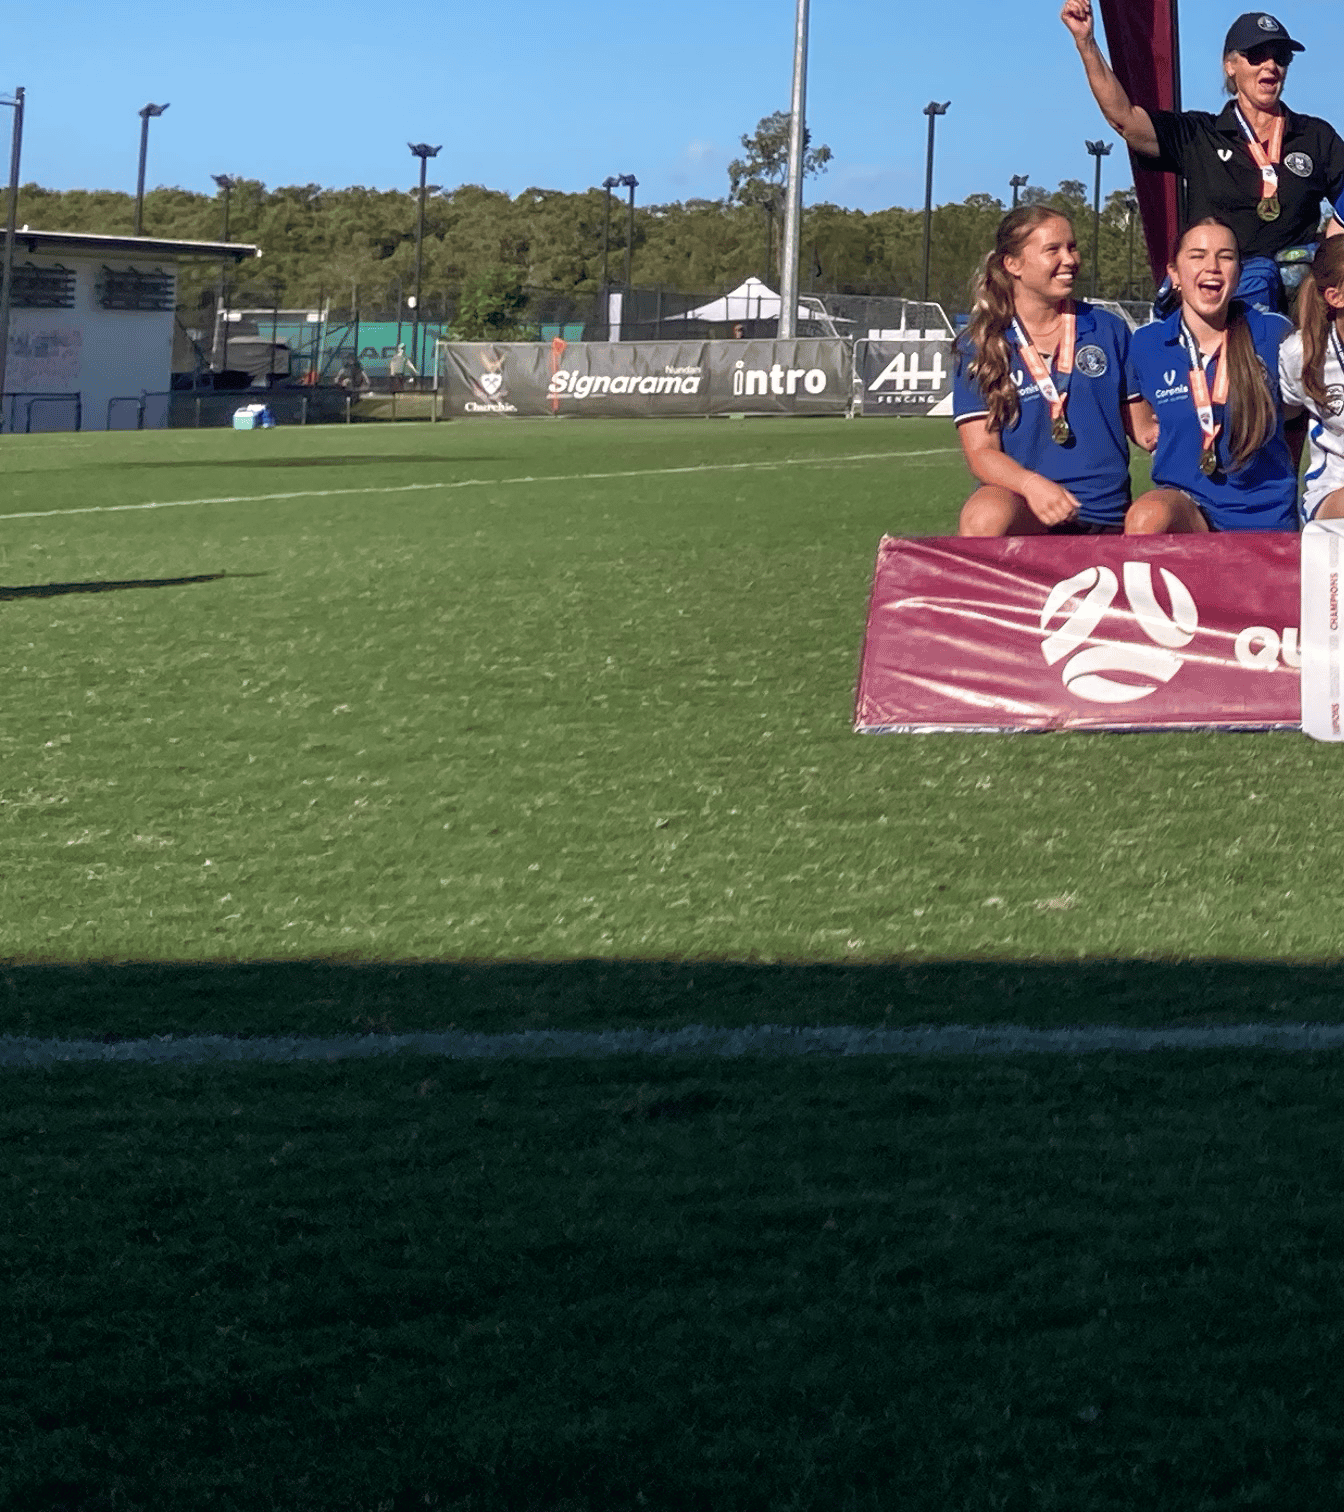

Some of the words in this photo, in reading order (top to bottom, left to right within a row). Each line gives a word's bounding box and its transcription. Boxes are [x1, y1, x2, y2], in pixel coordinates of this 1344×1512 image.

[548, 369, 701, 399] Signarama
[733, 360, 827, 395] intro
[868, 351, 947, 391] AH
[877, 395, 936, 404] FENCING
